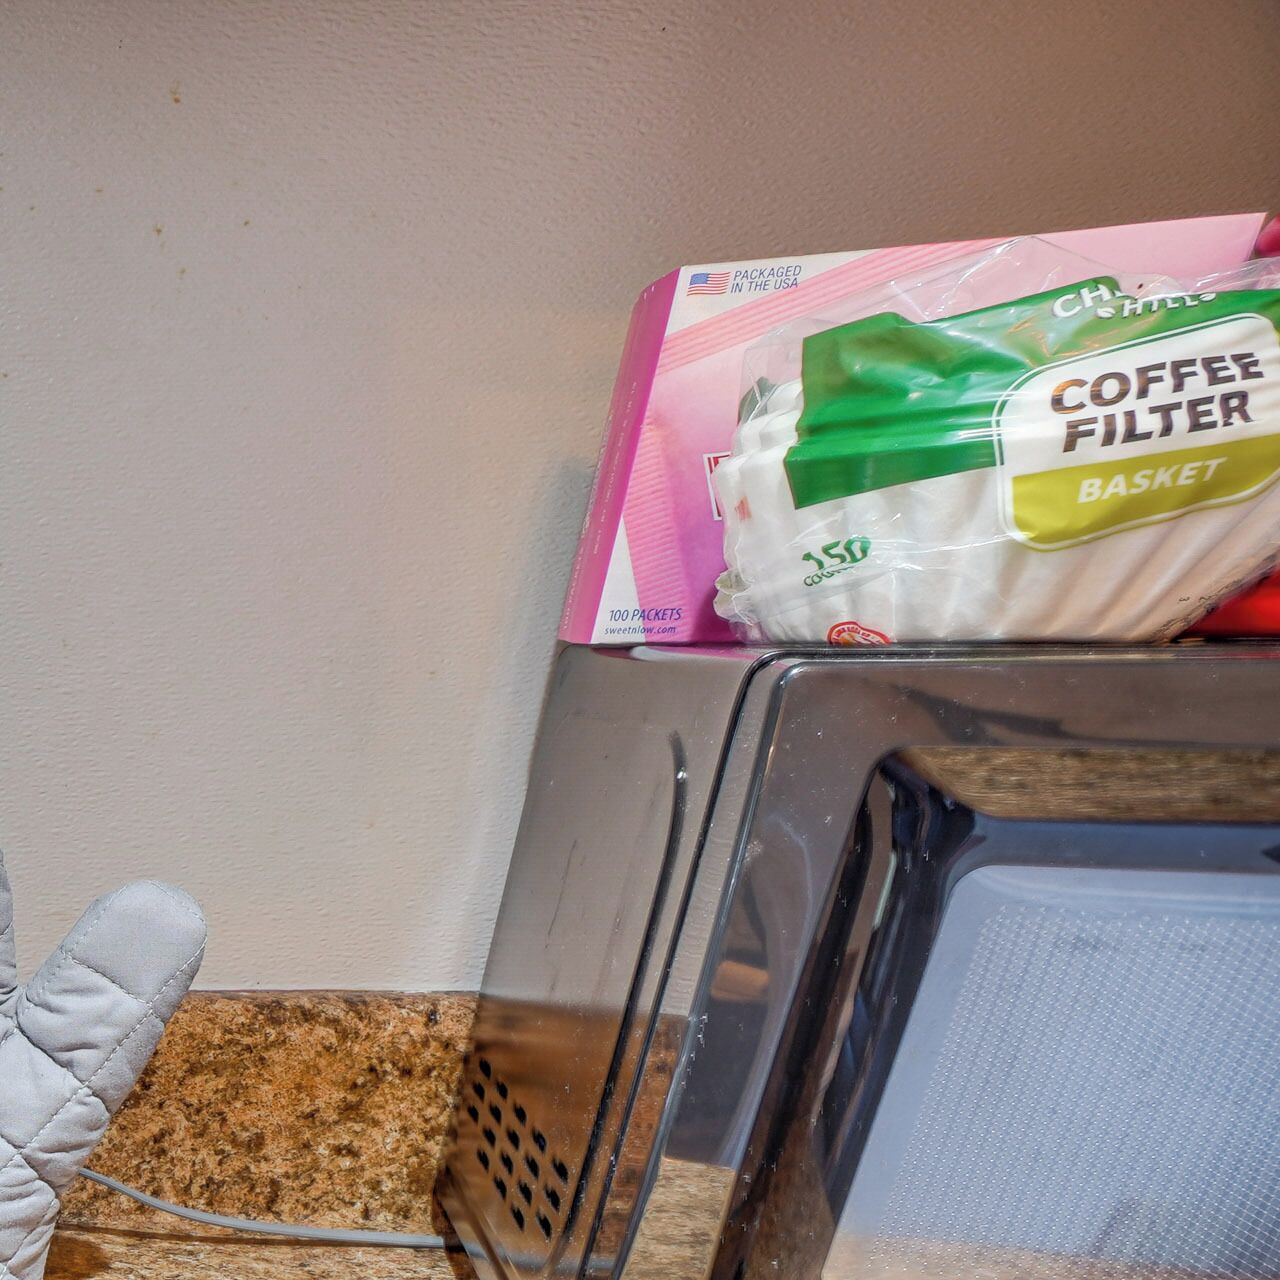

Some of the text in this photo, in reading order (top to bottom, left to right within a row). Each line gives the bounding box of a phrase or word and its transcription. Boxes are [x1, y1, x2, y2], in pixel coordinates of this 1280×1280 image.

[734, 265, 802, 281] PACKAGED
[731, 277, 798, 293] IN THE USA
[1051, 352, 1265, 415] COFFEE
[1062, 390, 1256, 453] FILTER
[1077, 457, 1229, 504] BASKET
[608, 607, 682, 622] 100 PACKETS
[604, 624, 676, 635] sweetnlow.com
